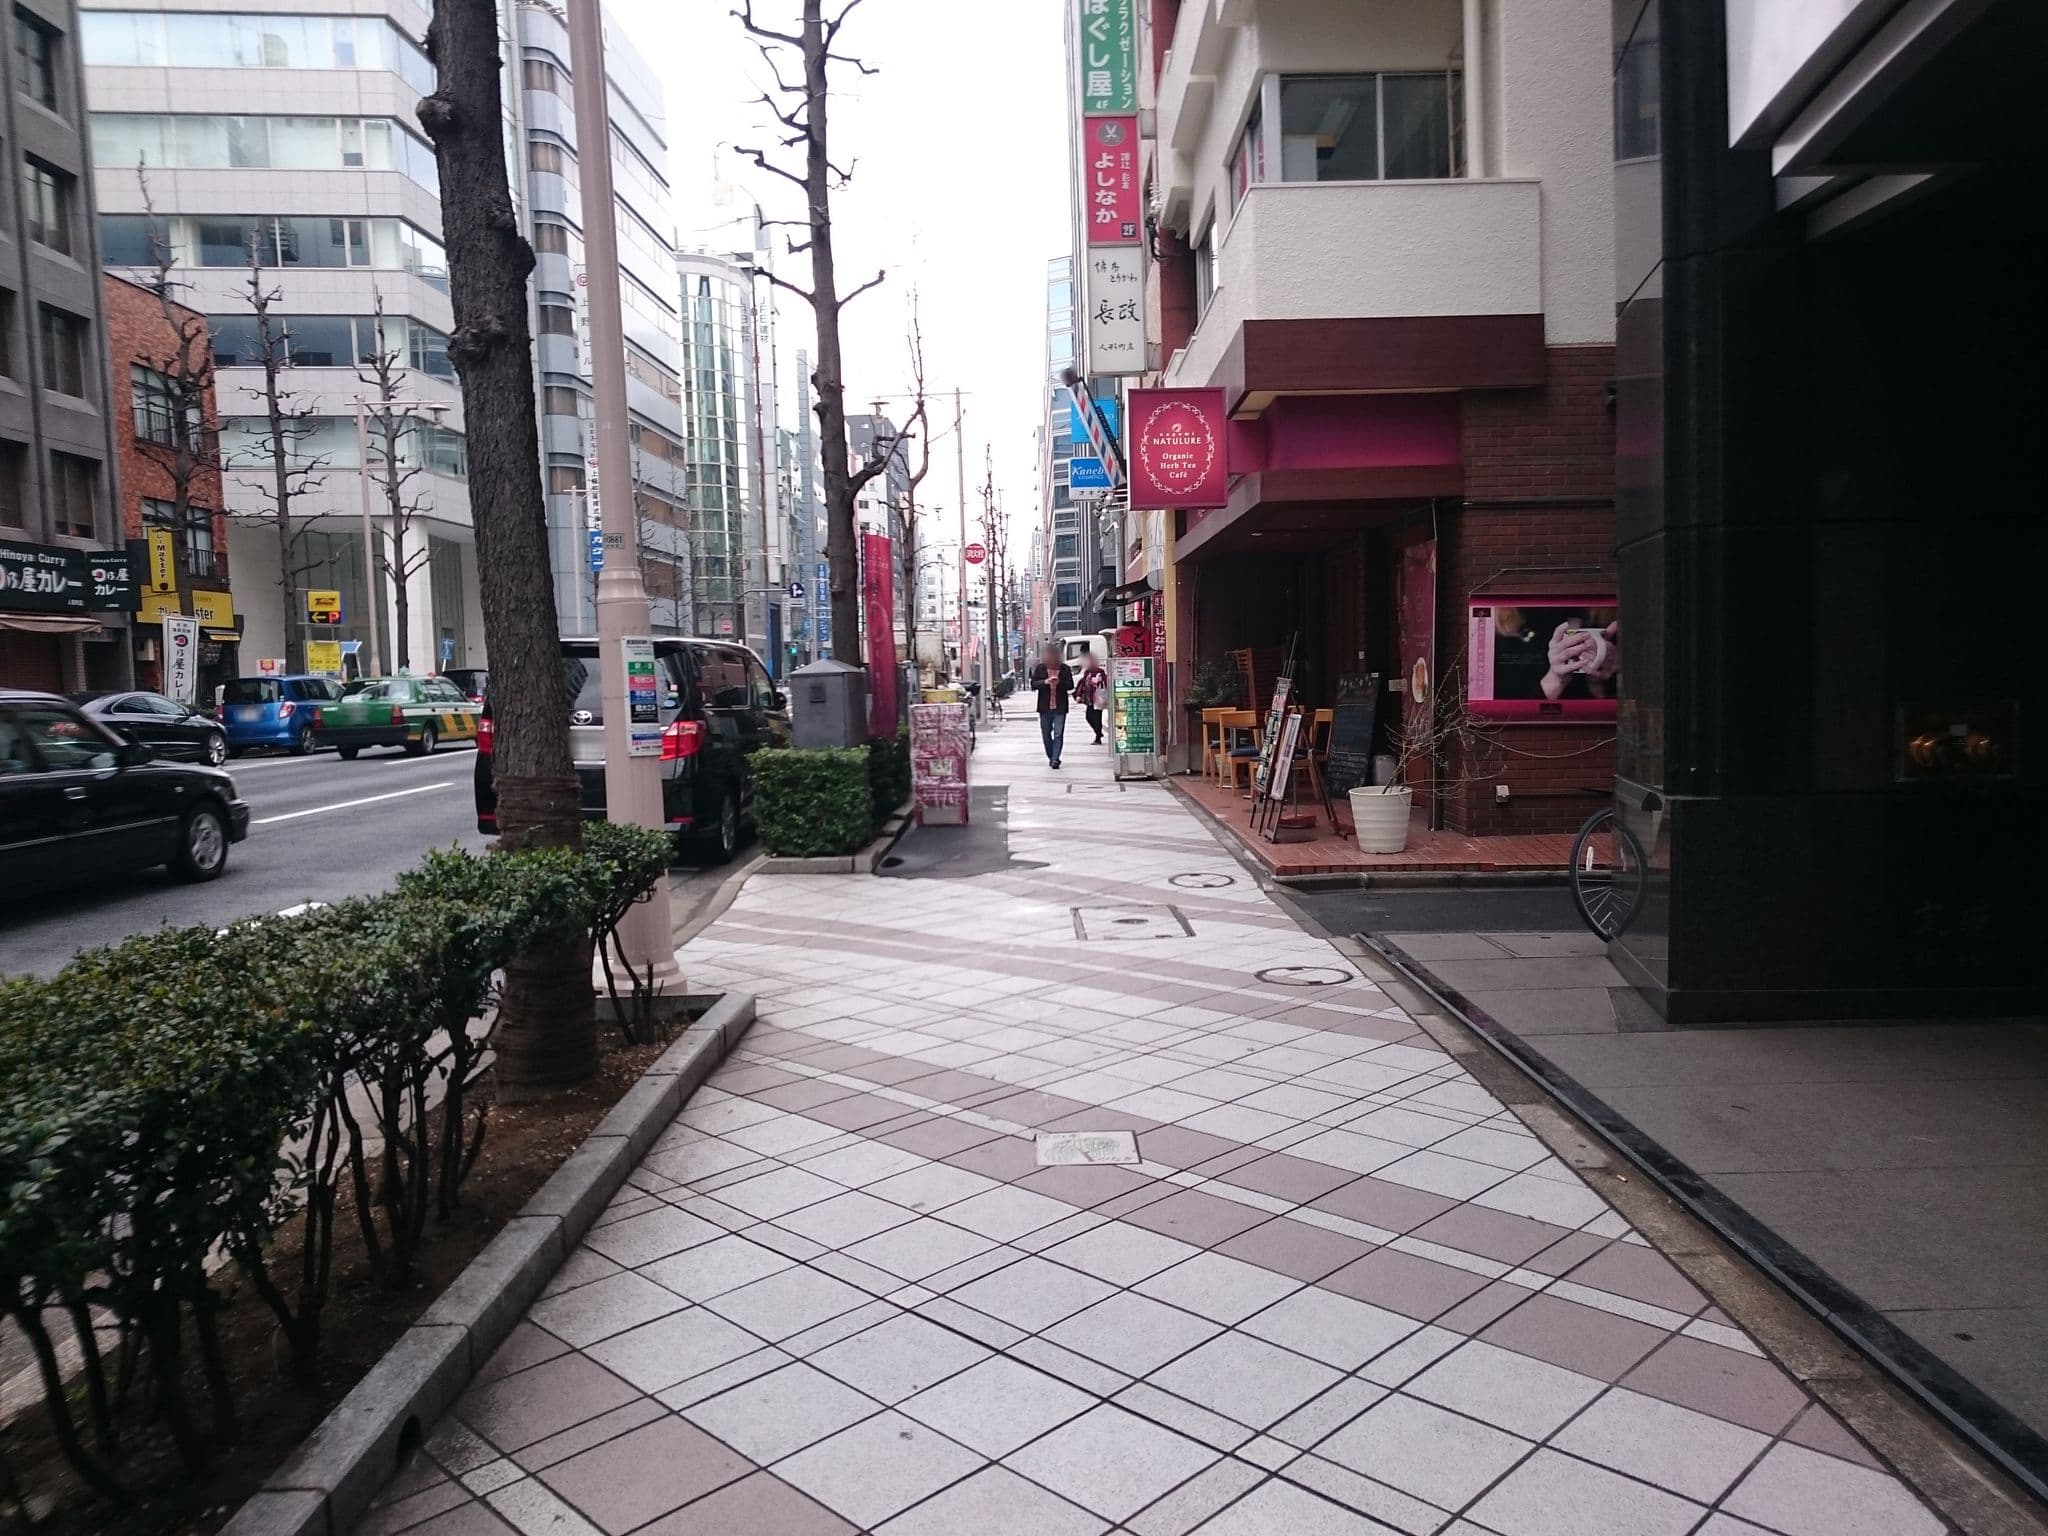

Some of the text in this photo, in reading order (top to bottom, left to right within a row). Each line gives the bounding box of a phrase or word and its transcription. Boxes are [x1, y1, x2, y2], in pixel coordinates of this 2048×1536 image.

[1084, 0, 1113, 96] ほぐし屋
[1096, 101, 1109, 109] 4F
[1095, 152, 1118, 223] よしなか
[1123, 225, 1135, 235] 2F
[1095, 299, 1140, 325] 長政
[1153, 437, 1201, 445] NATULURE
[1162, 452, 1193, 460] Organic
[1072, 465, 1104, 475] Kaneb
[38, 553, 66, 566] Curry
[94, 584, 128, 595] カレー
[195, 607, 214, 620] ster
[1155, 620, 1167, 653] よしなか
